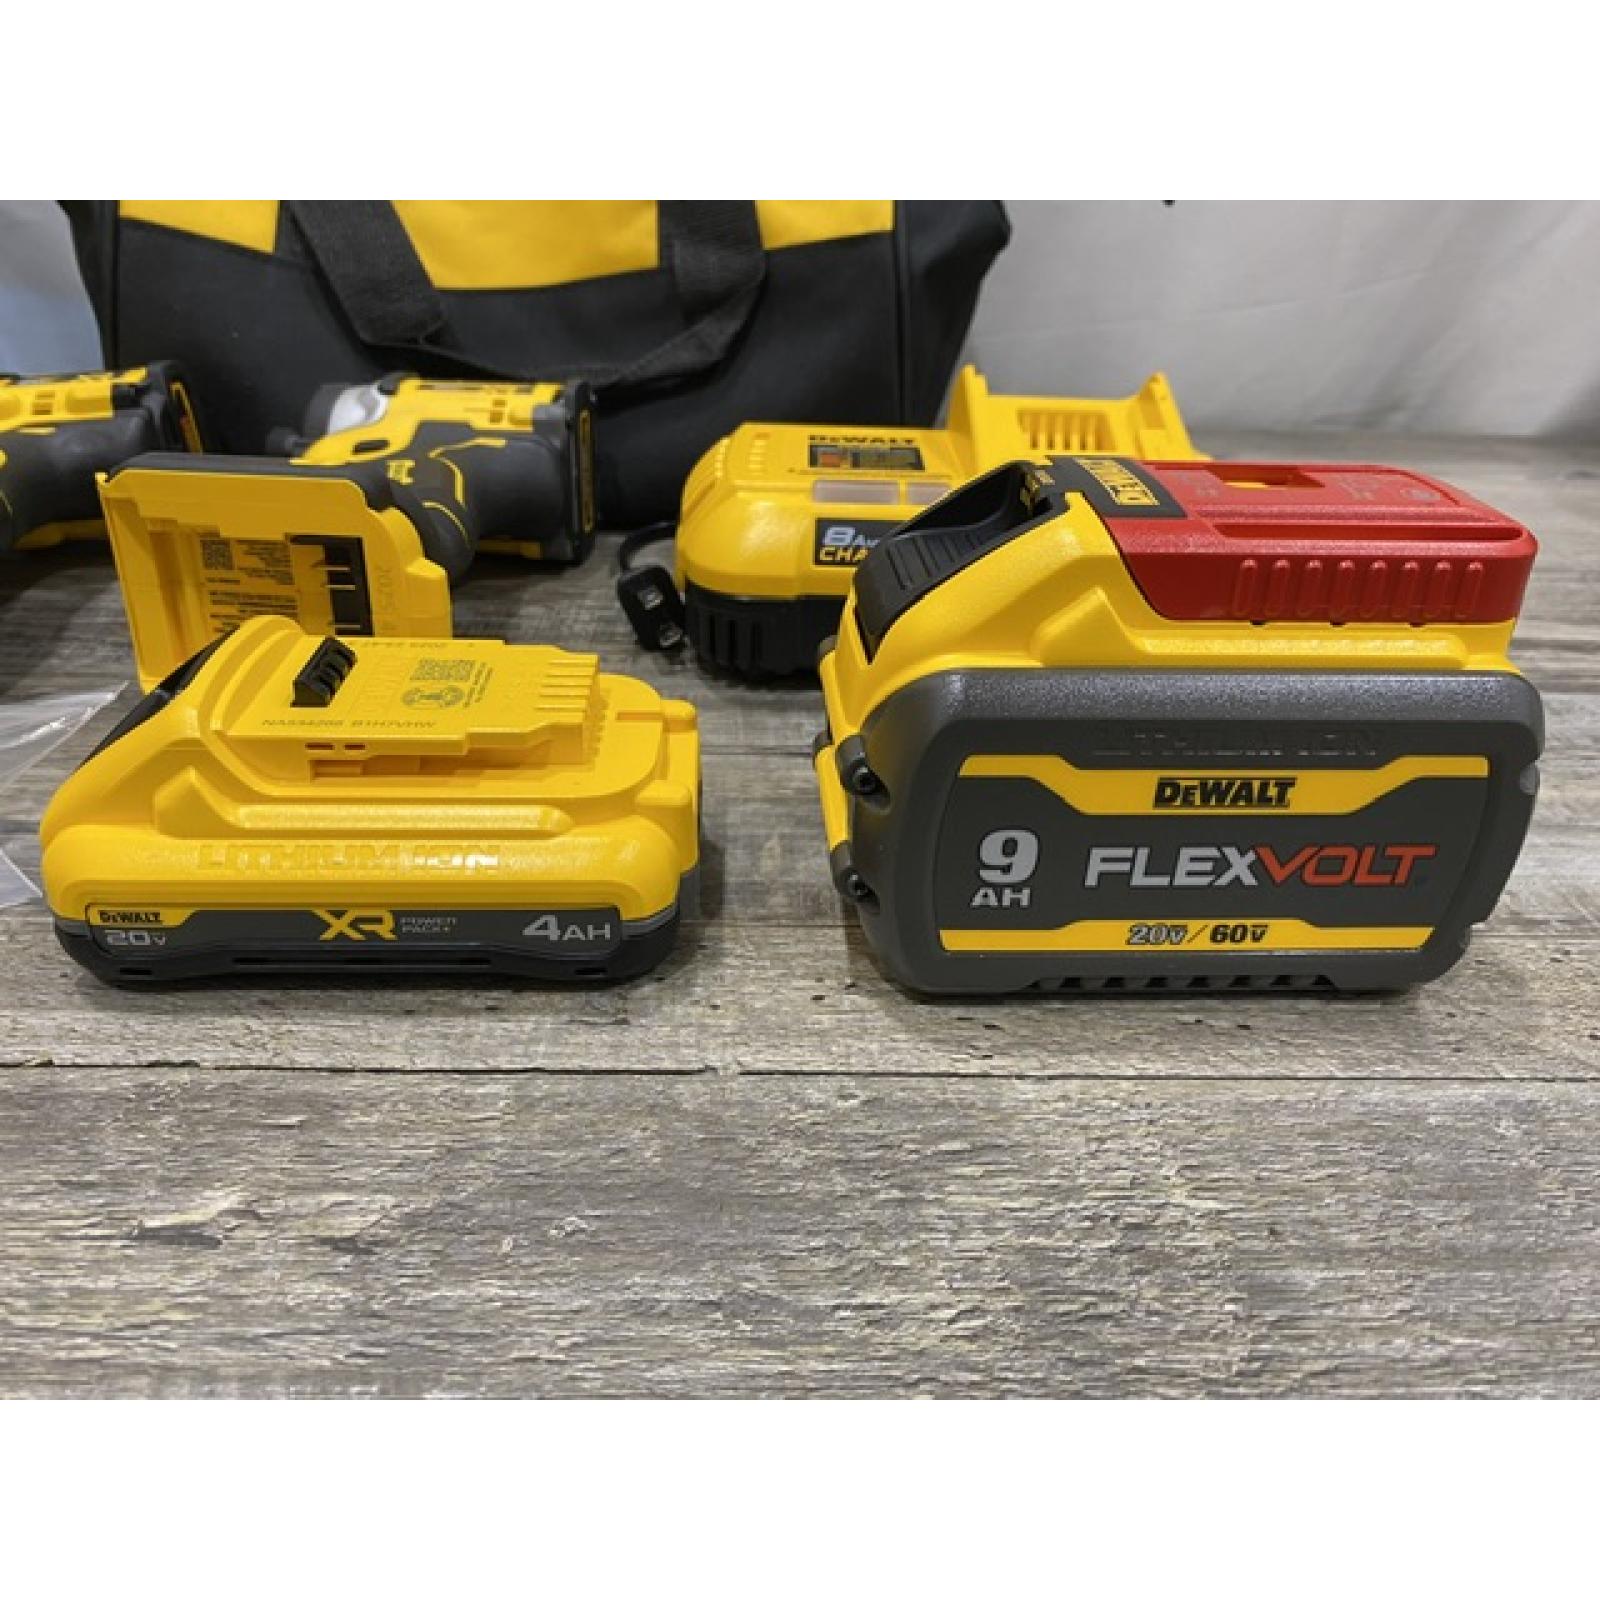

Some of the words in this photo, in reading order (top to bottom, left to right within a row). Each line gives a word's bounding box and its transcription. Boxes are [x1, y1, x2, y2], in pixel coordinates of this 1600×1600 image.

[979, 828, 1040, 884] 9
[1083, 846, 1436, 887] FLEXVOLT
[970, 887, 1031, 907] AH
[311, 909, 398, 941] XR
